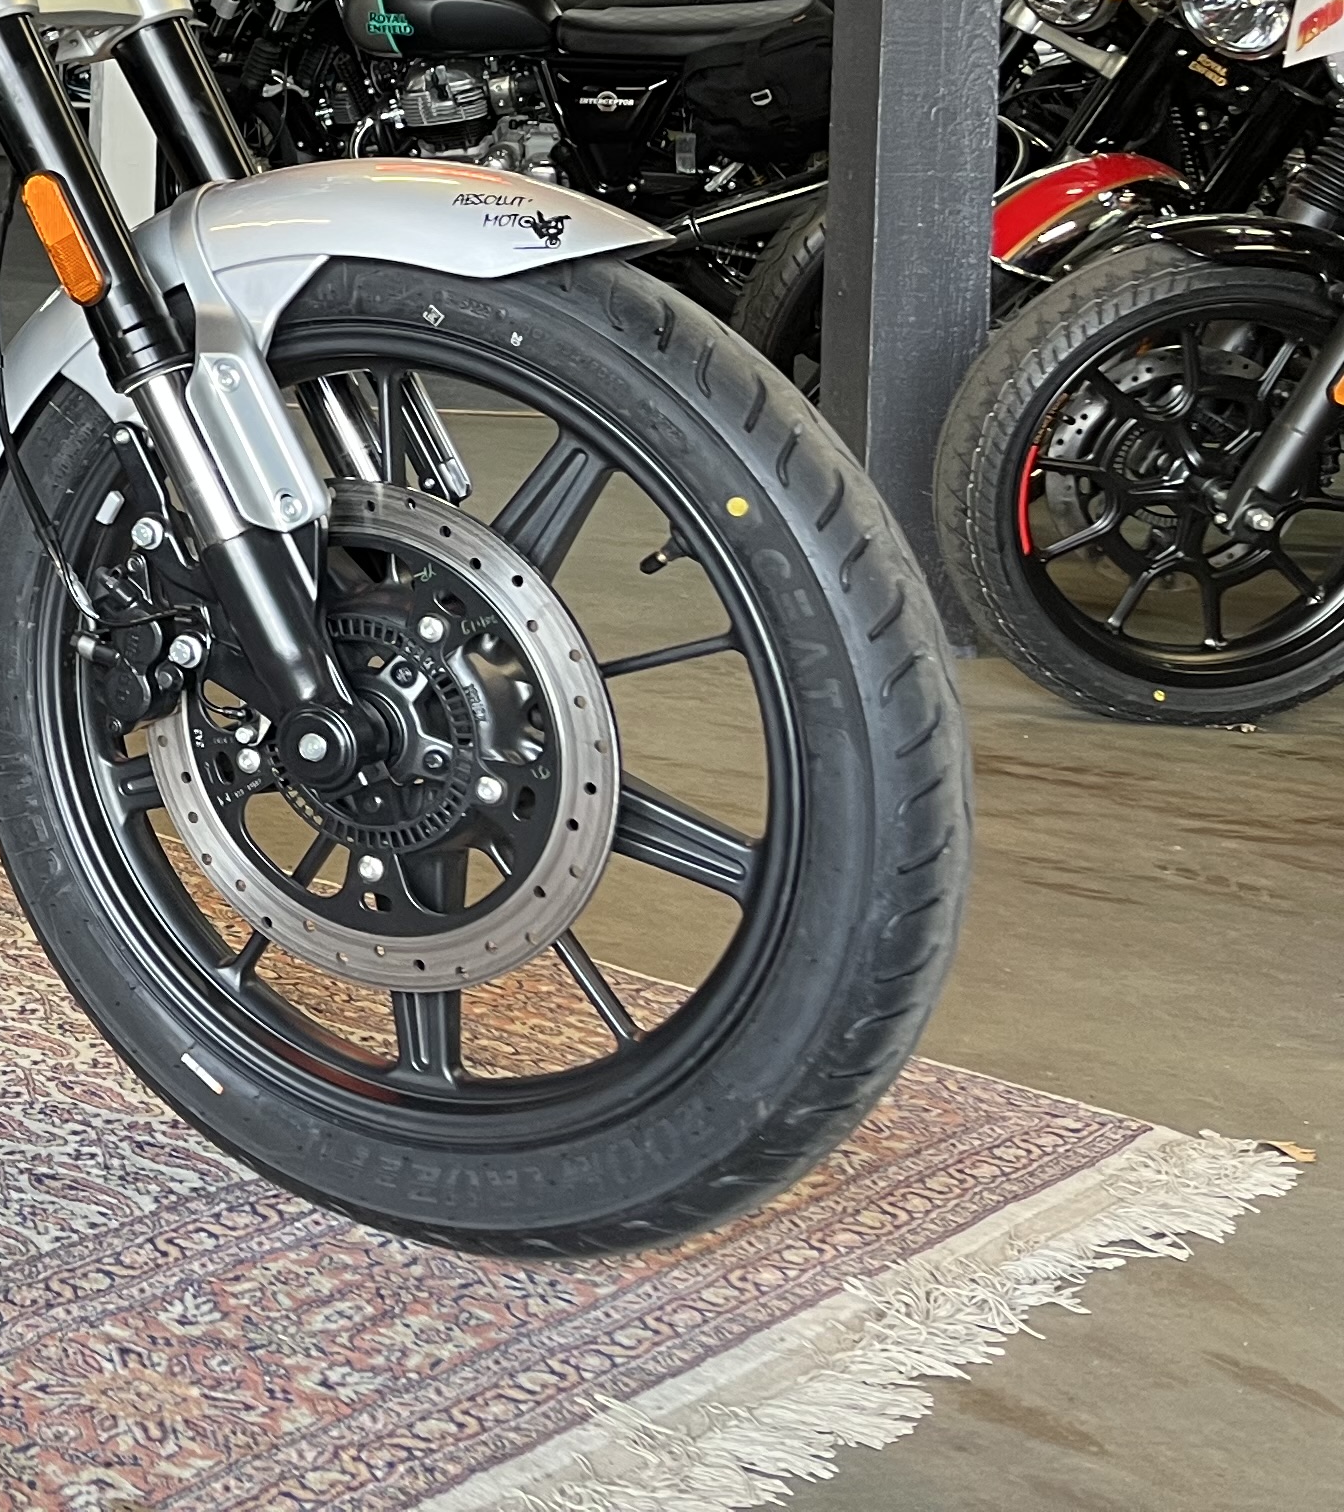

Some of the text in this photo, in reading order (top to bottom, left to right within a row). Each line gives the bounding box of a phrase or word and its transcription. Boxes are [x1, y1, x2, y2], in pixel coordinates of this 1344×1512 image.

[369, 12, 408, 24] ROYAL
[367, 23, 414, 36] ENFIELD
[578, 97, 635, 107] INTERCEPTOR
[750, 547, 846, 710] CEAT
